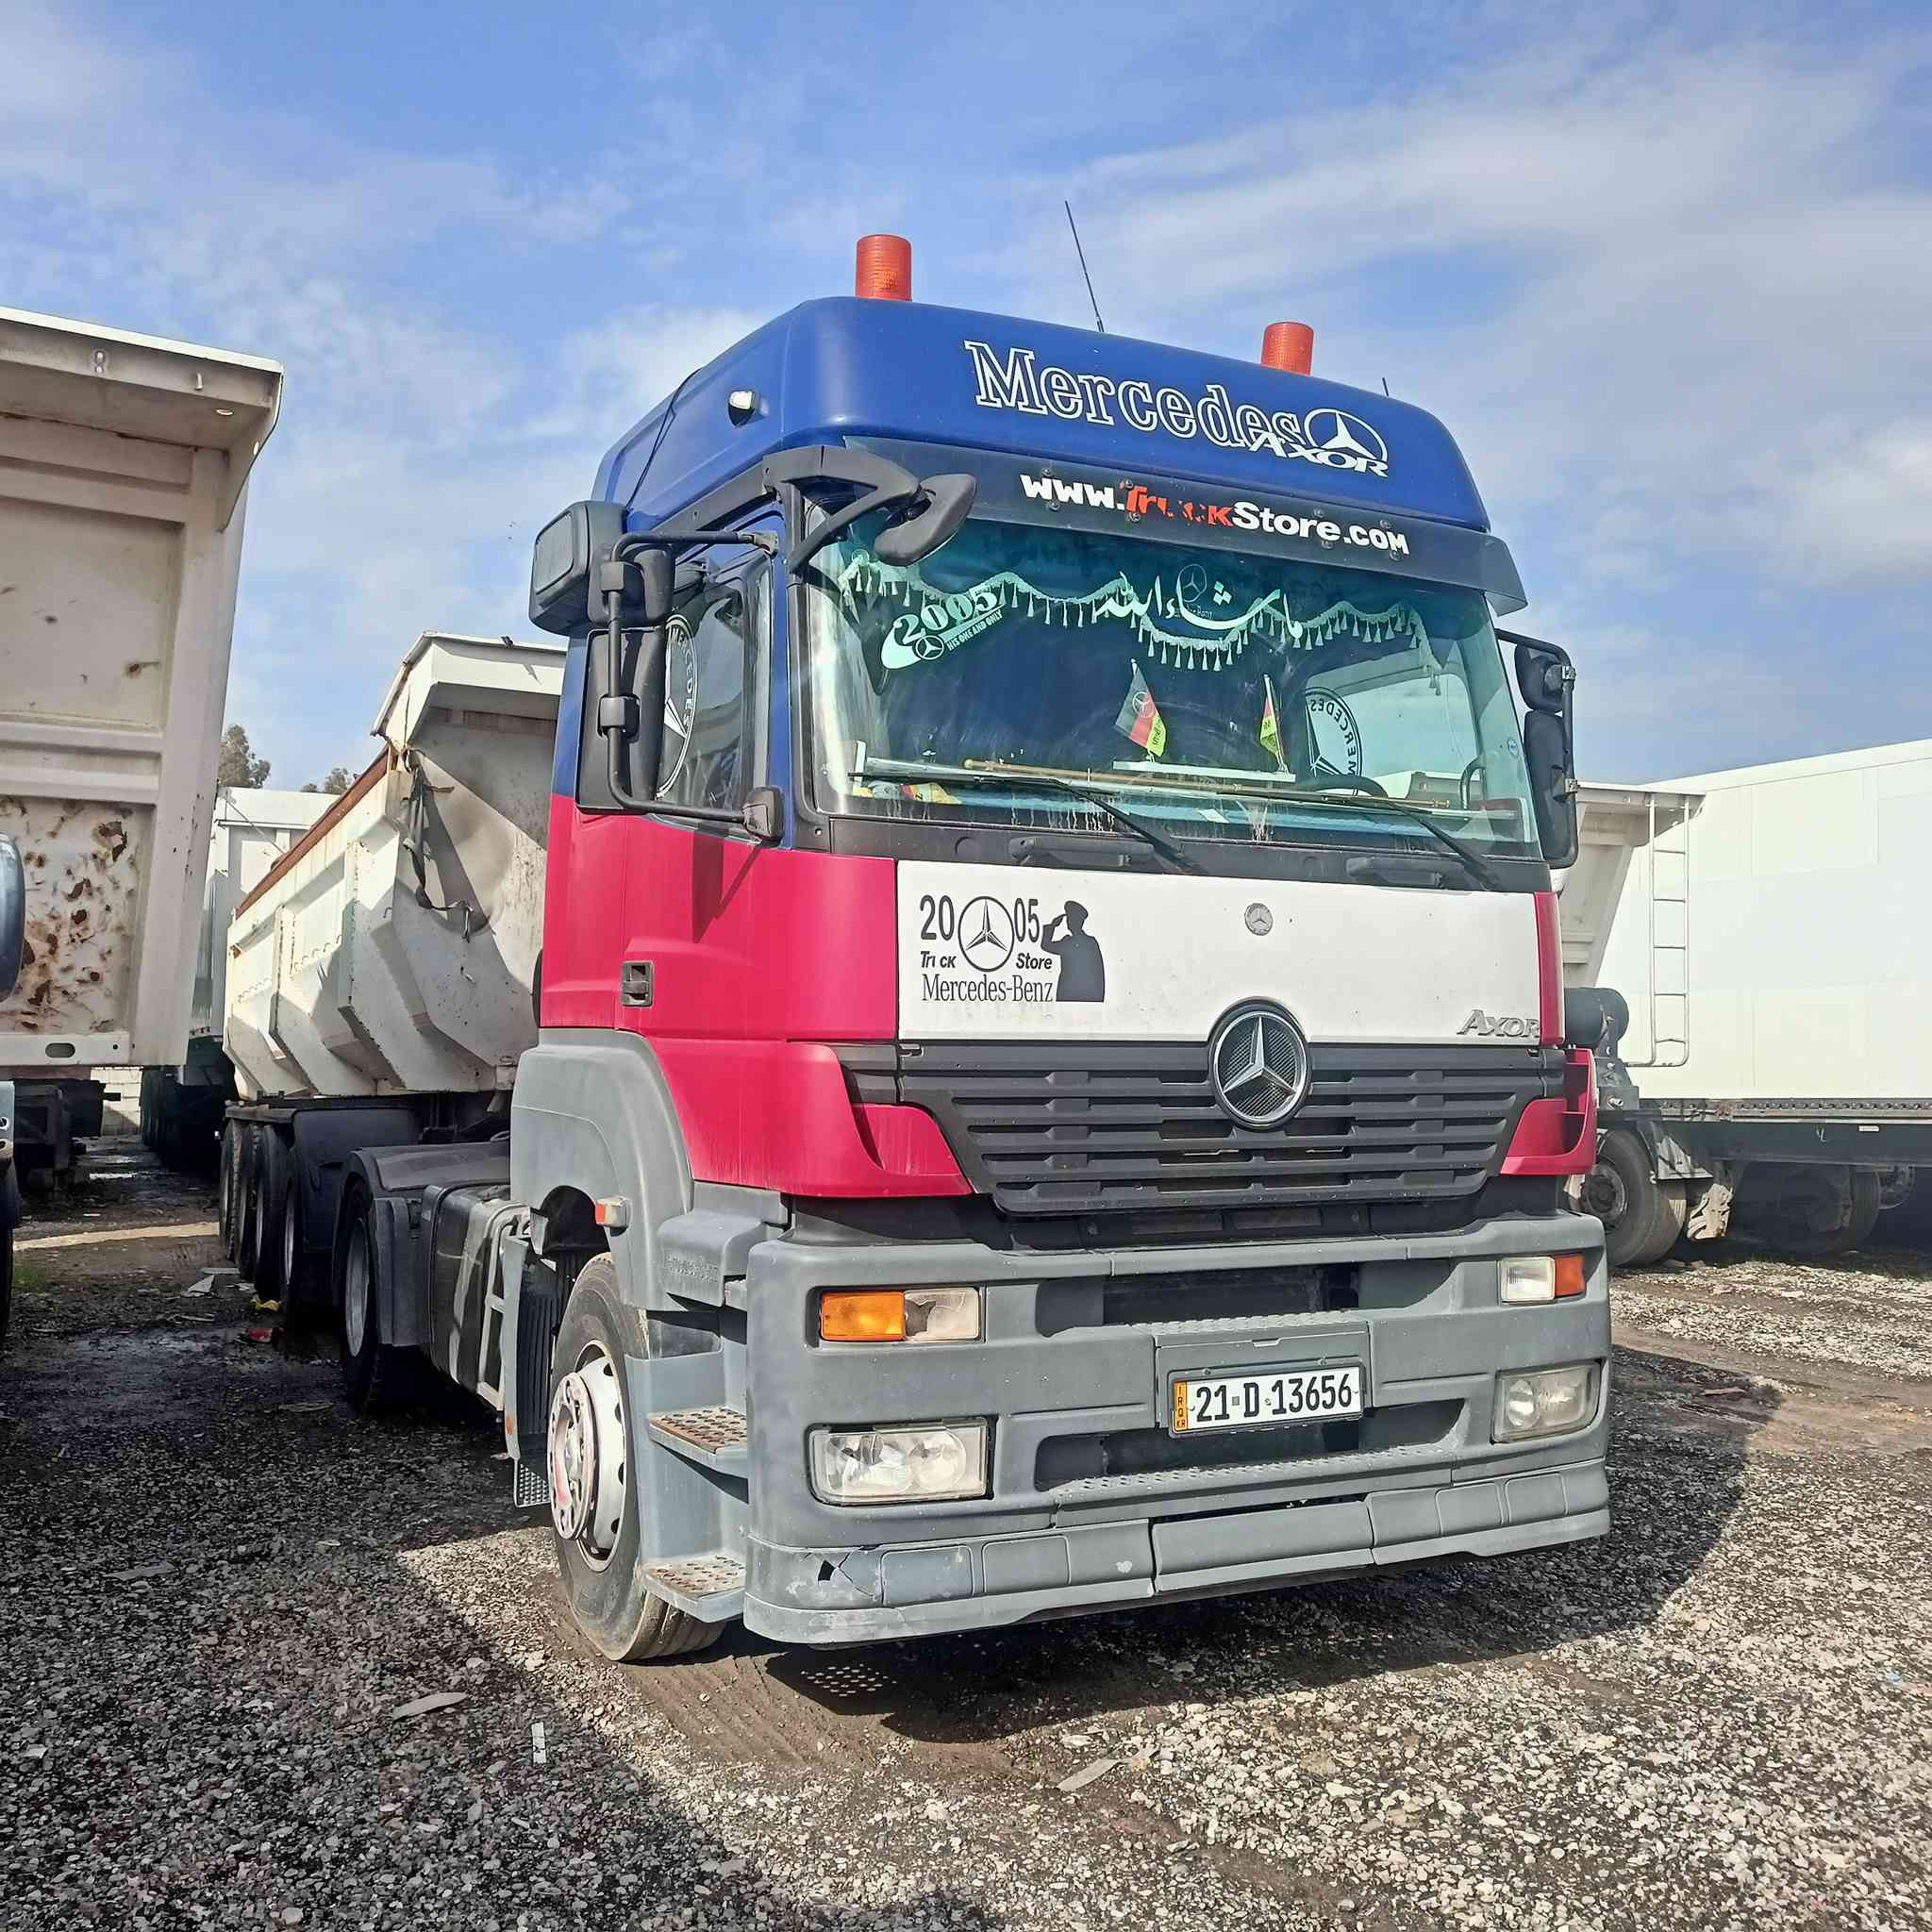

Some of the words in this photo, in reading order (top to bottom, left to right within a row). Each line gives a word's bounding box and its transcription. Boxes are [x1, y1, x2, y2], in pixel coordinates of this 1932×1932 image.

[964, 341, 1307, 450] Mercedes
[1249, 431, 1389, 478] AXOR
[892, 586, 999, 645] 2005
[920, 894, 955, 941] 20
[1014, 898, 1040, 942] 05
[1016, 953, 1053, 970] Store
[922, 974, 1053, 1002] Mercedes-Benz
[1196, 1385, 1230, 1422] 21
[1243, 1382, 1259, 1417] D
[1272, 1374, 1352, 1415] 13656
